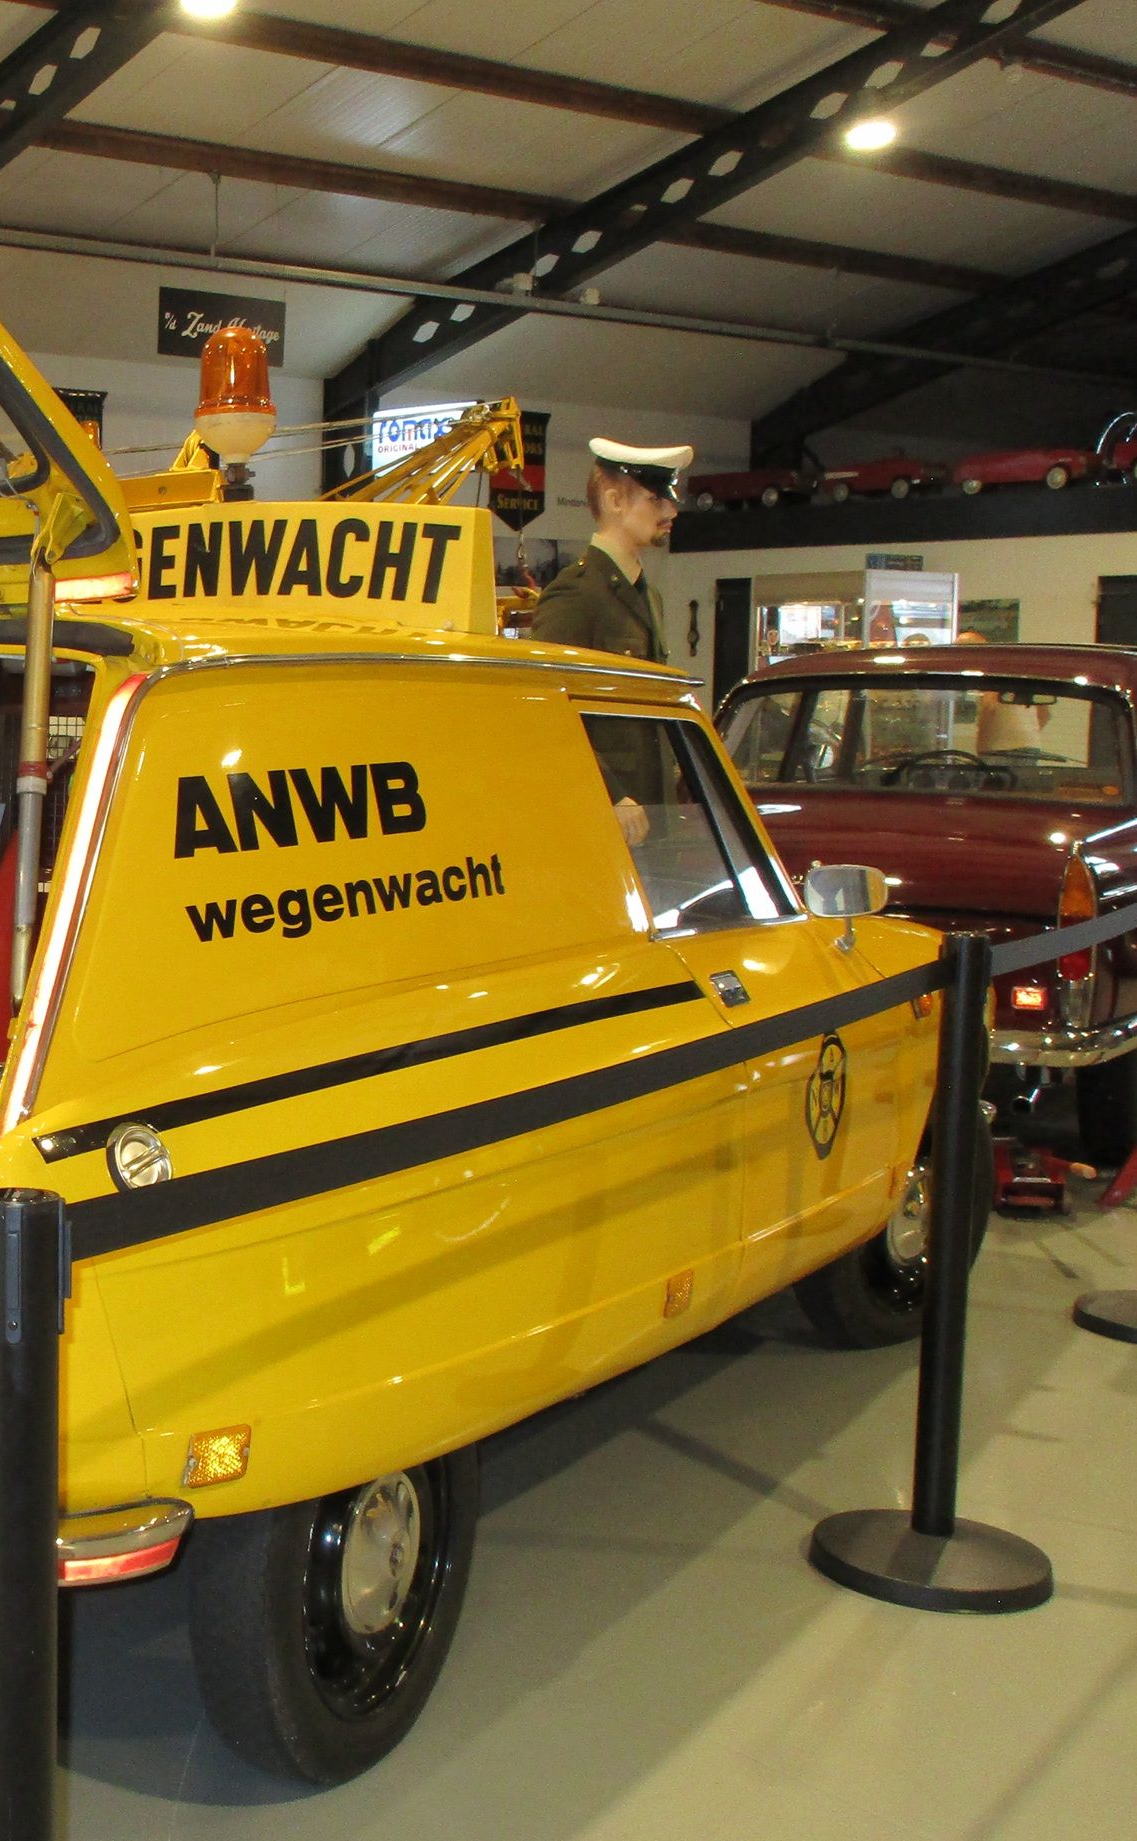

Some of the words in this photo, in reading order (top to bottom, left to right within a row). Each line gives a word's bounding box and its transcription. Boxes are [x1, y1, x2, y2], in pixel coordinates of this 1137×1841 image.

[181, 311, 222, 339] Zand
[174, 761, 427, 860] ANWB
[185, 853, 506, 943] wegenwacht
